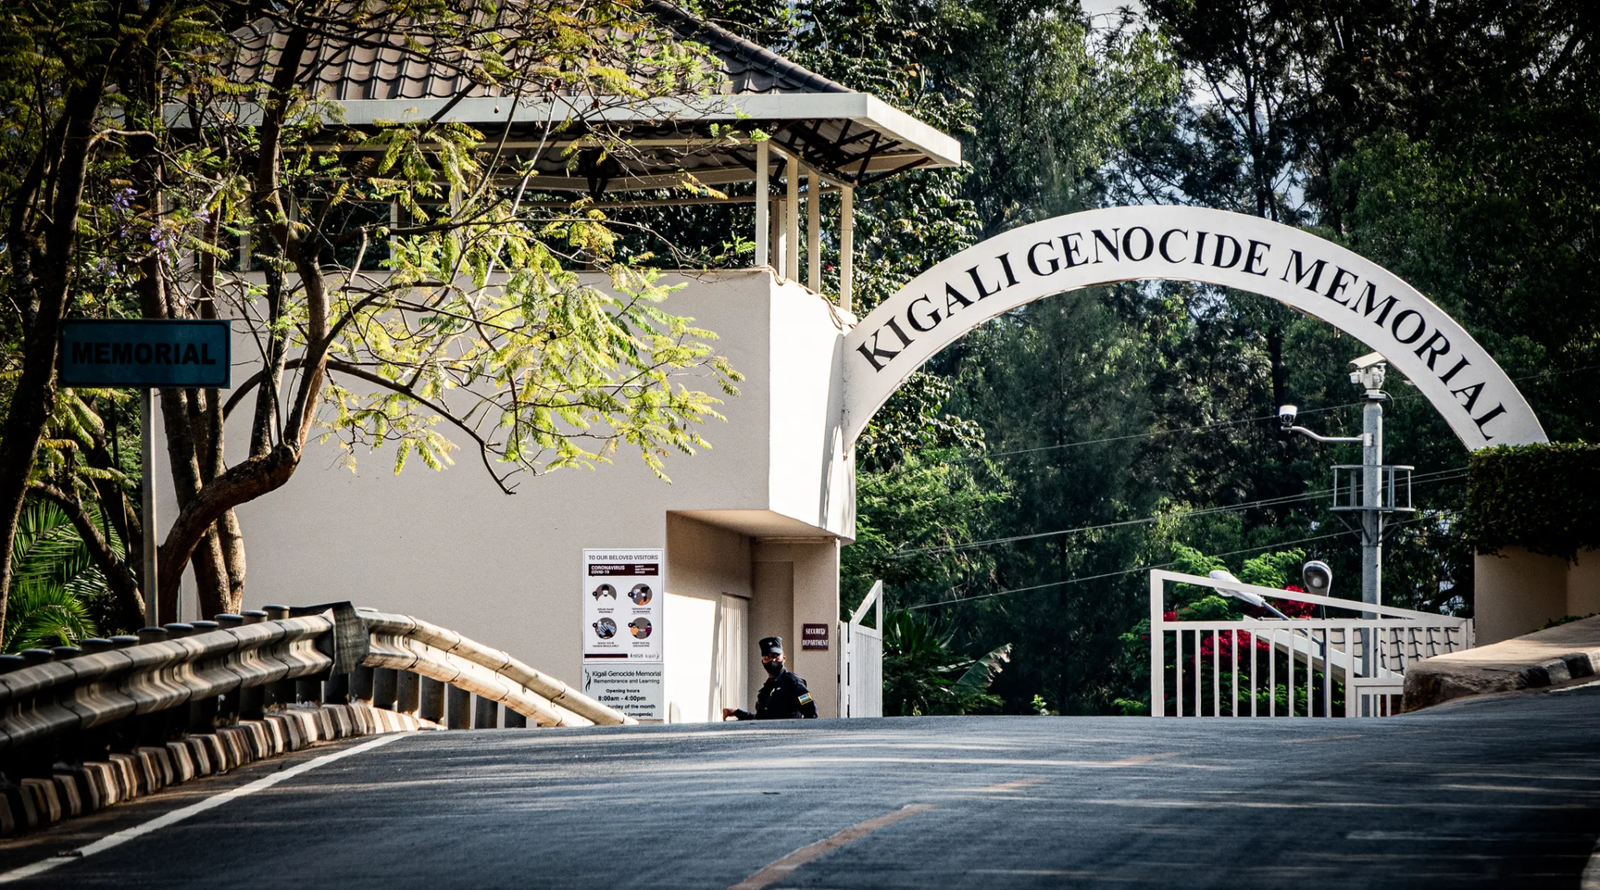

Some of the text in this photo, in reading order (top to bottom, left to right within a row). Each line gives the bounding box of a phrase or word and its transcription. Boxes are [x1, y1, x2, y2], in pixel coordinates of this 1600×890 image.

[72, 342, 216, 365] MEMORIAL
[856, 226, 1508, 441] KIGALI GENOCIDE MEMORIAL
